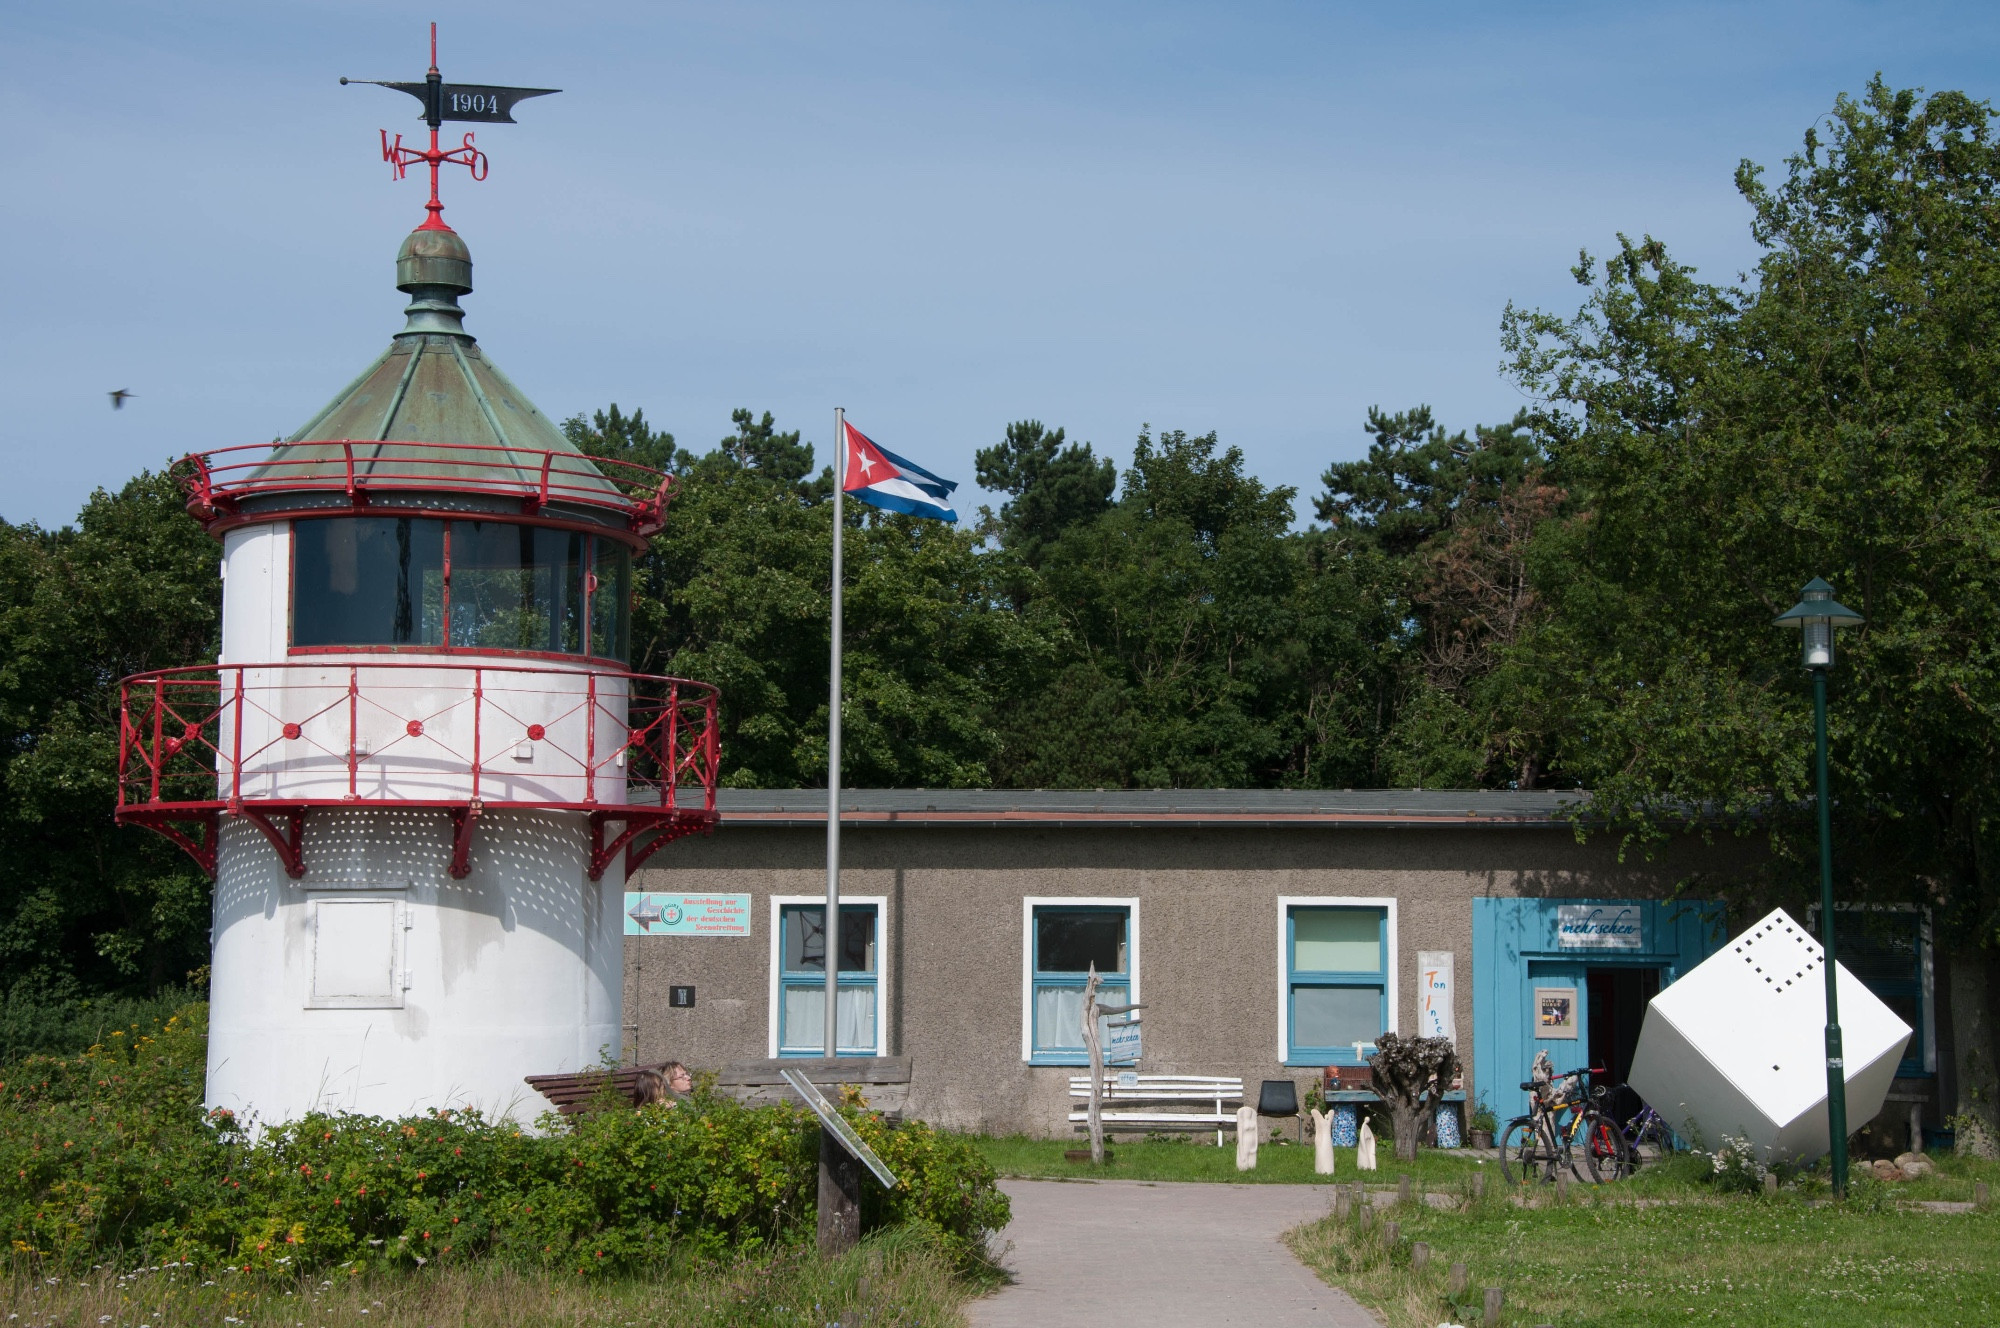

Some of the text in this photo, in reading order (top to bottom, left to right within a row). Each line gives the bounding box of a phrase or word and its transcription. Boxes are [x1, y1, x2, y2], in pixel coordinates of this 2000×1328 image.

[450, 93, 498, 114] 1904
[683, 898, 723, 906] Ausstellung
[700, 915, 736, 923] deutschen
[1424, 970, 1446, 989] Ton
[1425, 994, 1443, 1034] Inse
